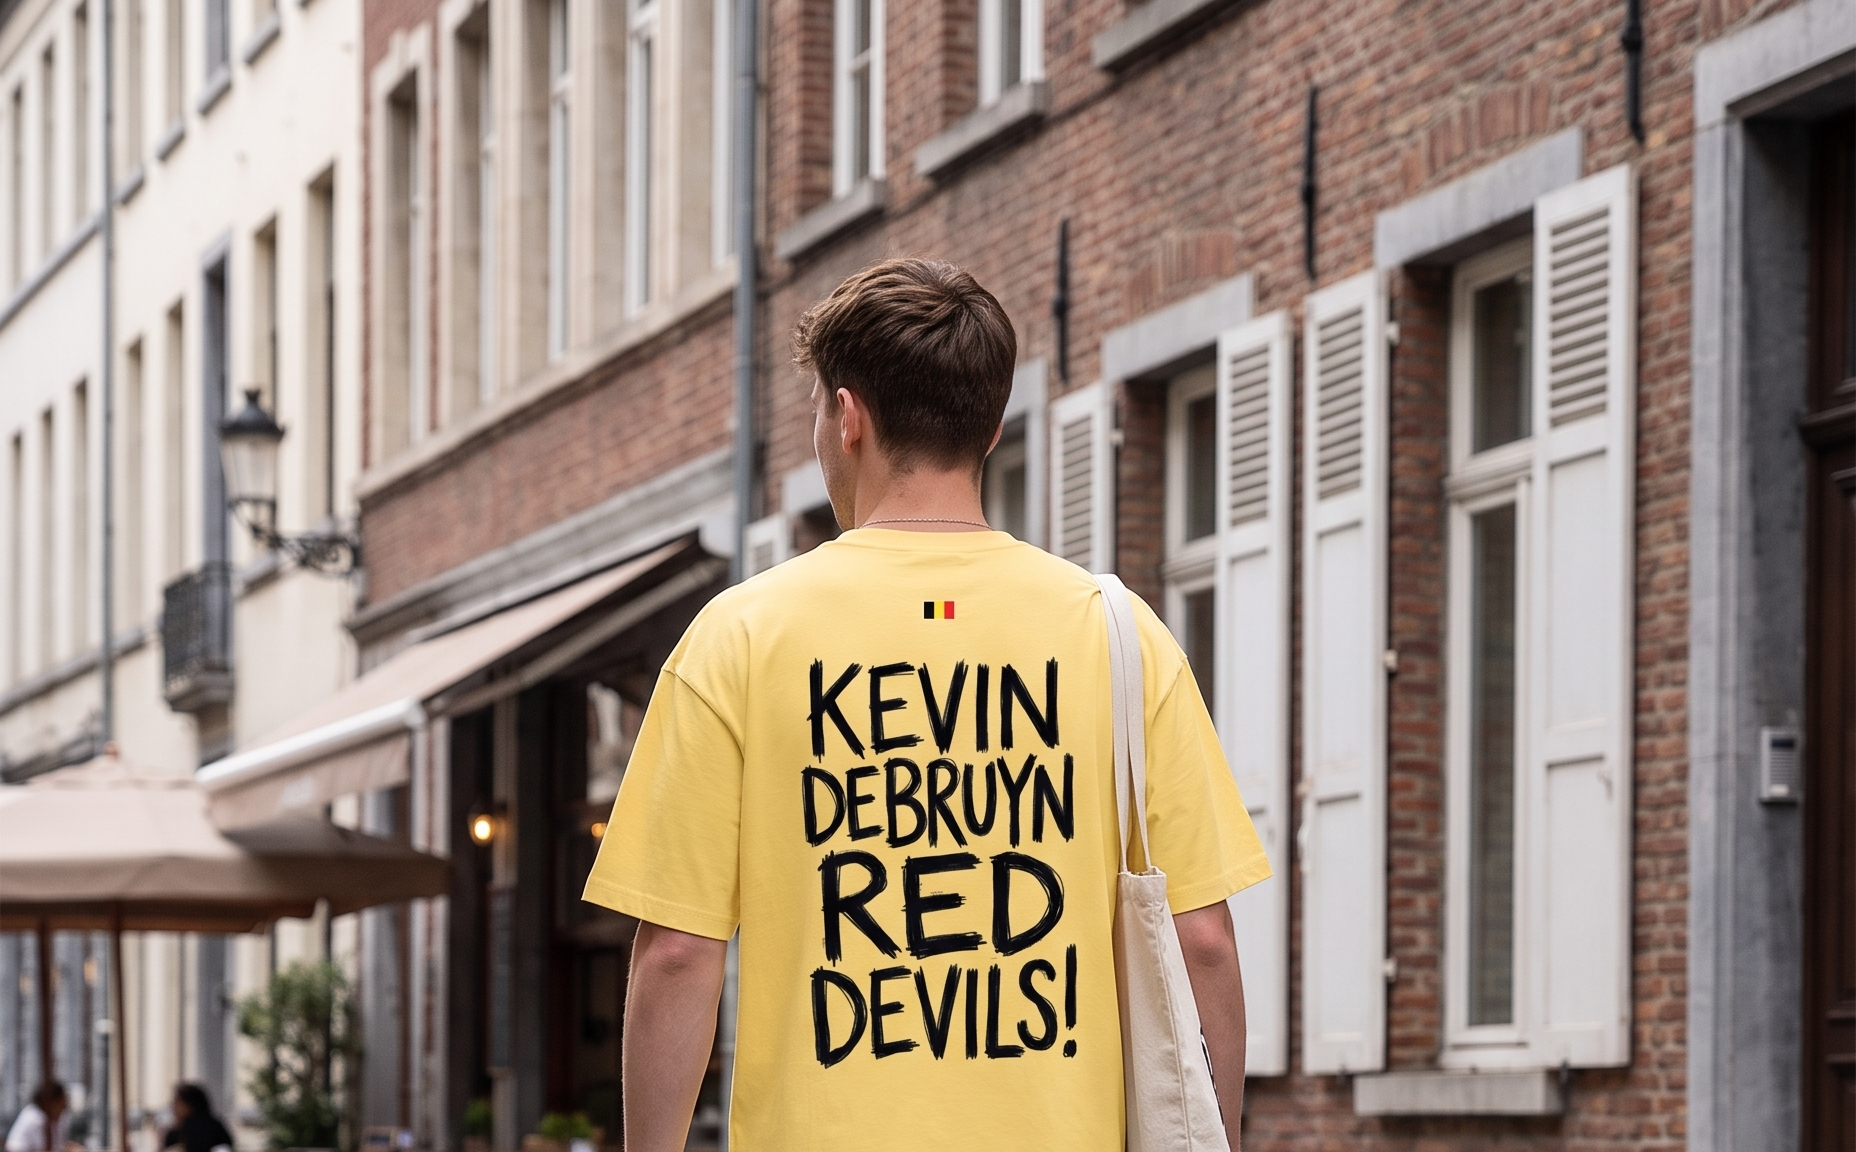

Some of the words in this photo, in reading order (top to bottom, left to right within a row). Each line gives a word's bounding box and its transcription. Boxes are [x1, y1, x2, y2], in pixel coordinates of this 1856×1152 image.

[807, 657, 1060, 763] KEVIN
[801, 753, 1074, 848] DEBRUYN
[818, 850, 1065, 967] RED
[810, 943, 1077, 1069] DEVILS!
